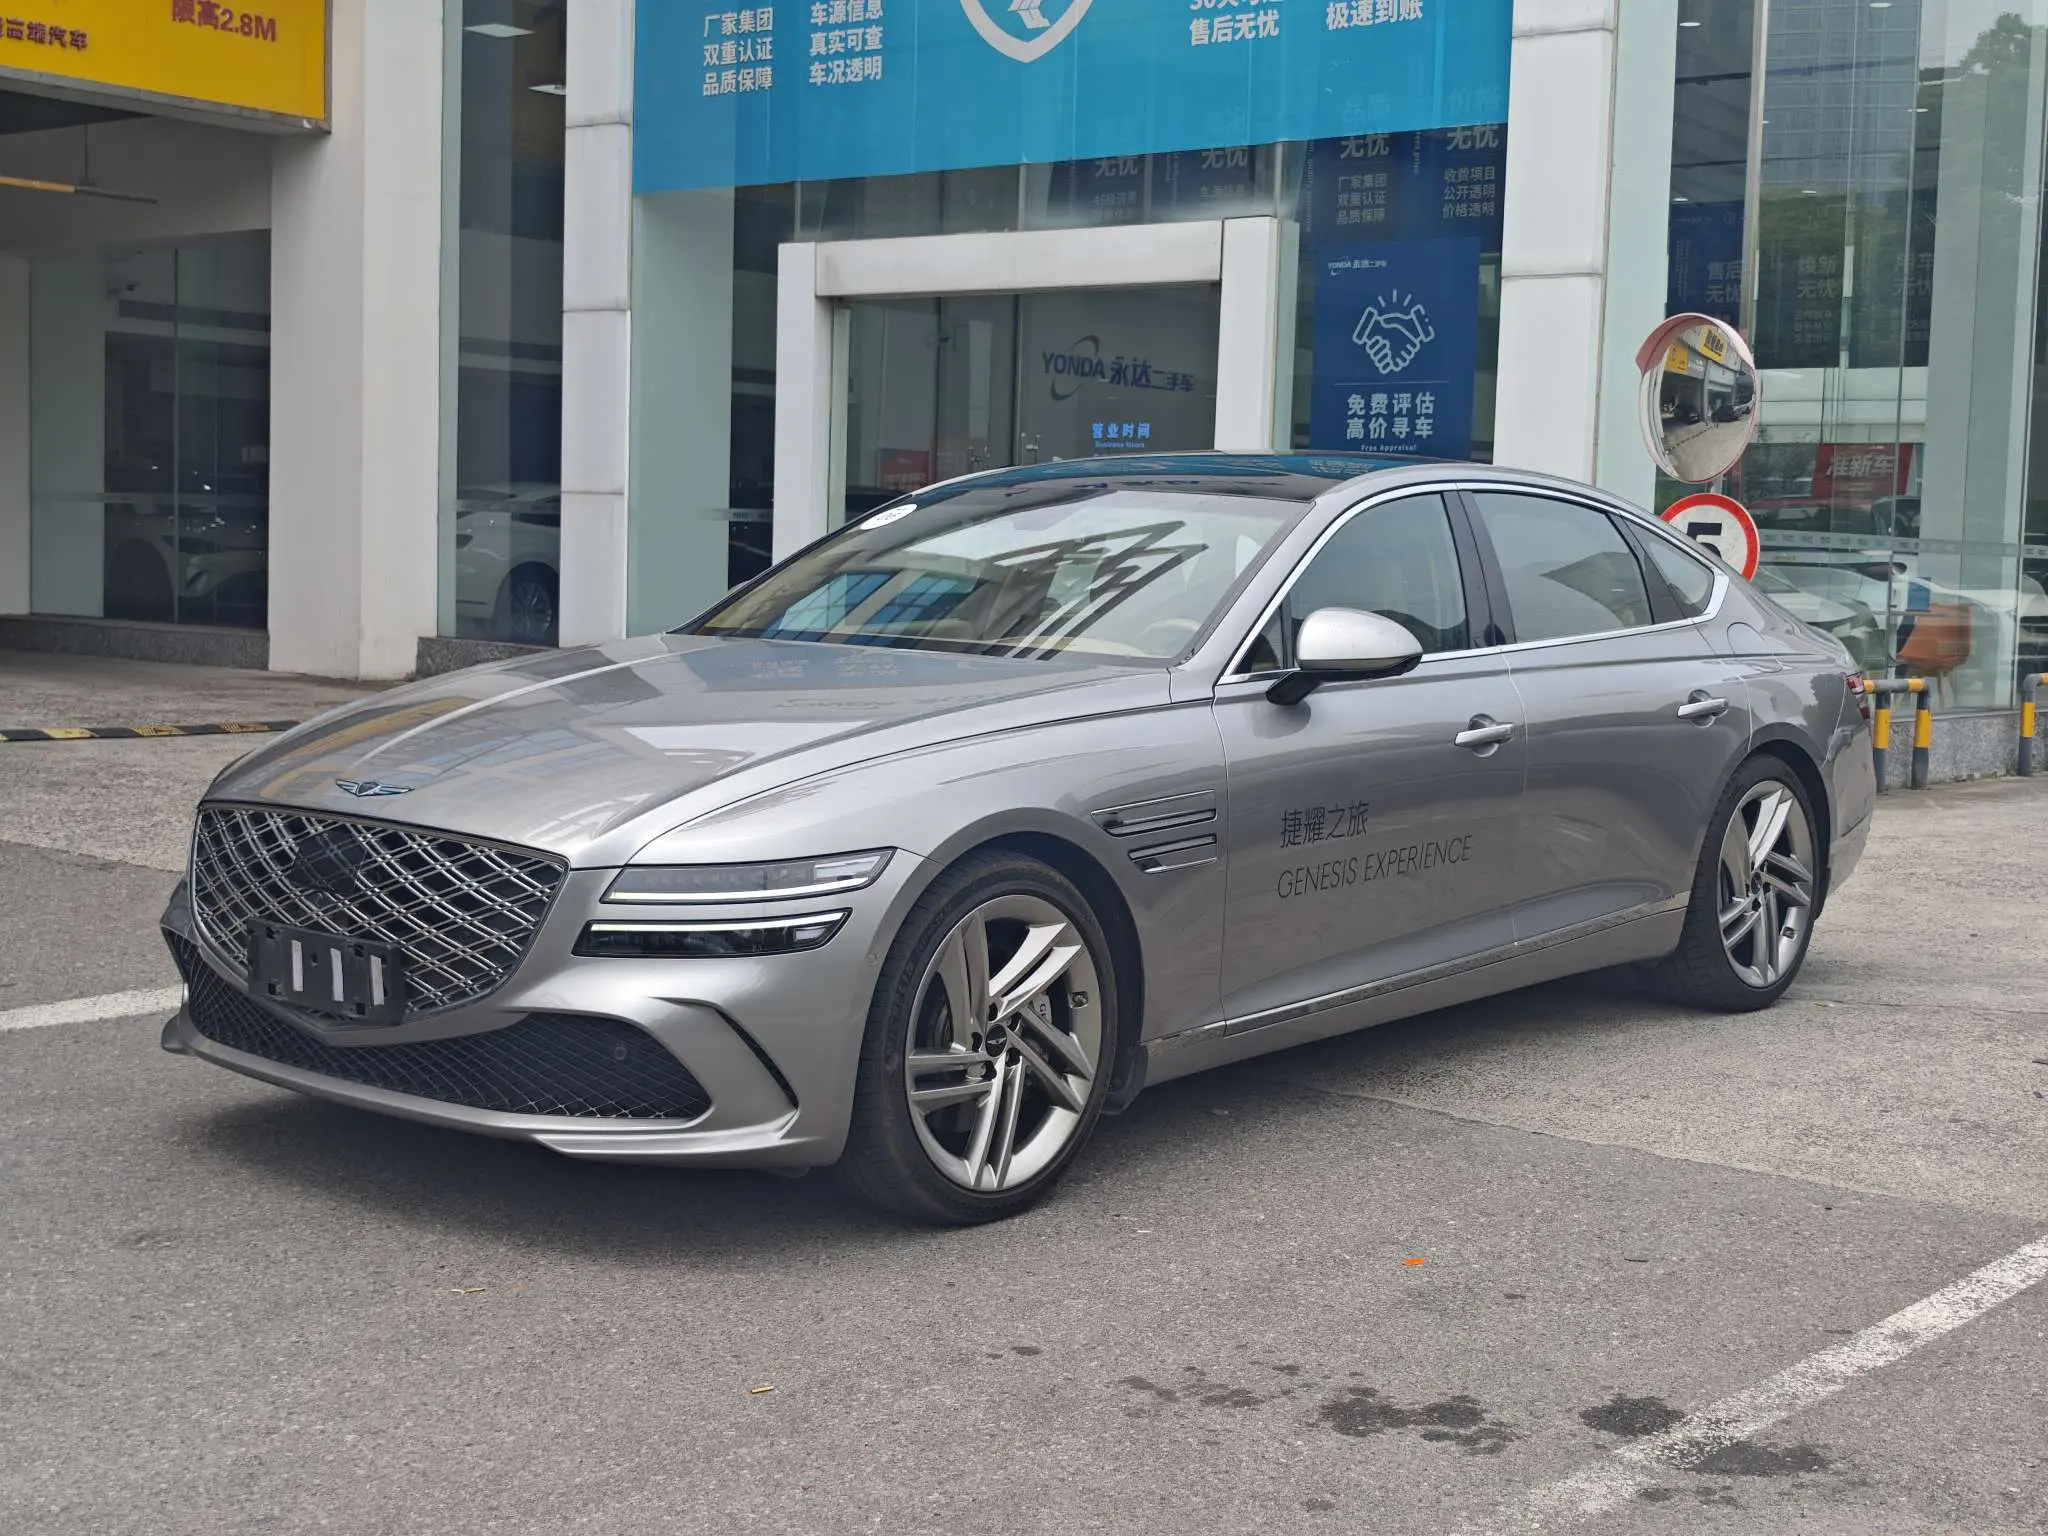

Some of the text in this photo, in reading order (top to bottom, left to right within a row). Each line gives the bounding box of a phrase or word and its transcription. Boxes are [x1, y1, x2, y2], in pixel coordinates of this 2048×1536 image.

[703, 7, 774, 38] 厂家集团
[810, 0, 884, 27] 车源信息
[1189, 9, 1280, 46] 售后无忧
[1326, 0, 1424, 31] 极速到账
[703, 37, 774, 68] 双重认证
[809, 25, 884, 57] 真实可查
[703, 67, 774, 97] 品质保障
[809, 55, 883, 87] 车况透明
[1337, 173, 1387, 190] 厂家集团
[1444, 166, 1495, 182] 收费项目
[1443, 183, 1495, 201] 公开透明
[1336, 208, 1386, 226] 品质保障
[1442, 201, 1495, 219] 价格透明
[1042, 350, 1197, 393] YONDA 永达二手车
[1347, 391, 1435, 416] 免费评估
[1091, 422, 1151, 440] 营业时间
[1346, 416, 1434, 440] 高价寻车
[1279, 800, 1370, 849] 捷耀之旅
[1277, 834, 1473, 899] GENESIS EXPERIENCE
